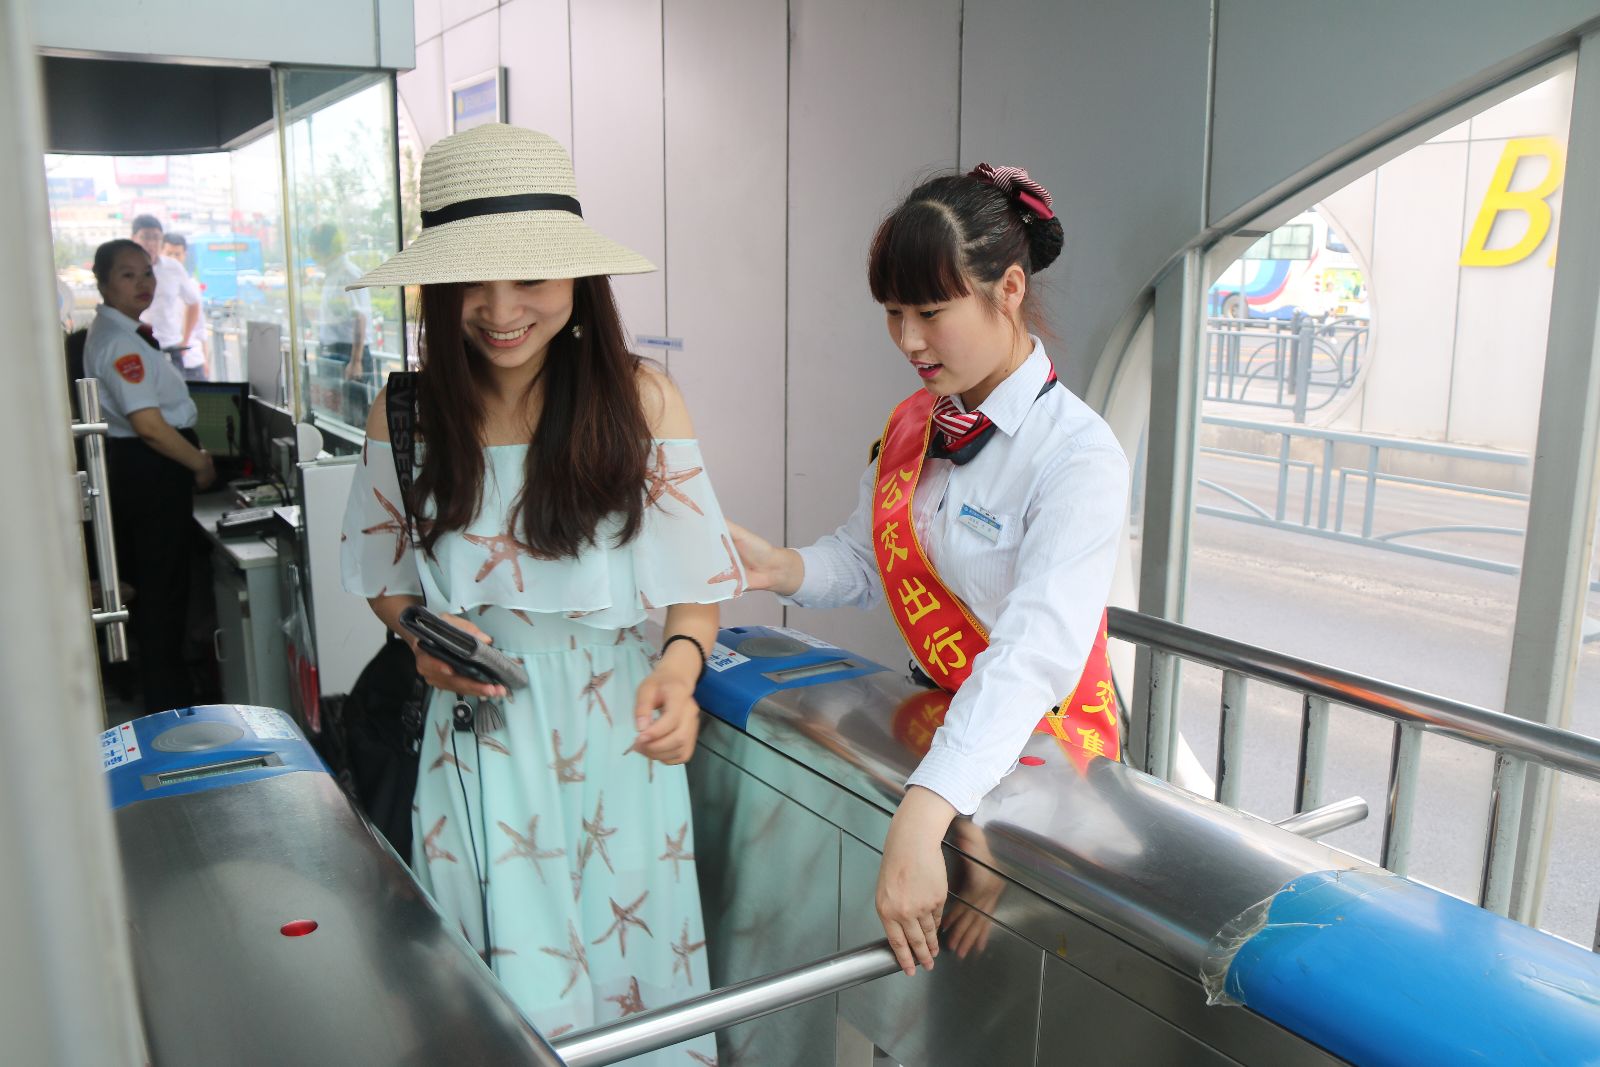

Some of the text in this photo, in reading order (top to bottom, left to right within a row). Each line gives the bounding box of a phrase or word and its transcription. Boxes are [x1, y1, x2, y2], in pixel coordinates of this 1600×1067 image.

[1458, 134, 1566, 268] B
[880, 468, 967, 676] 公交出行
